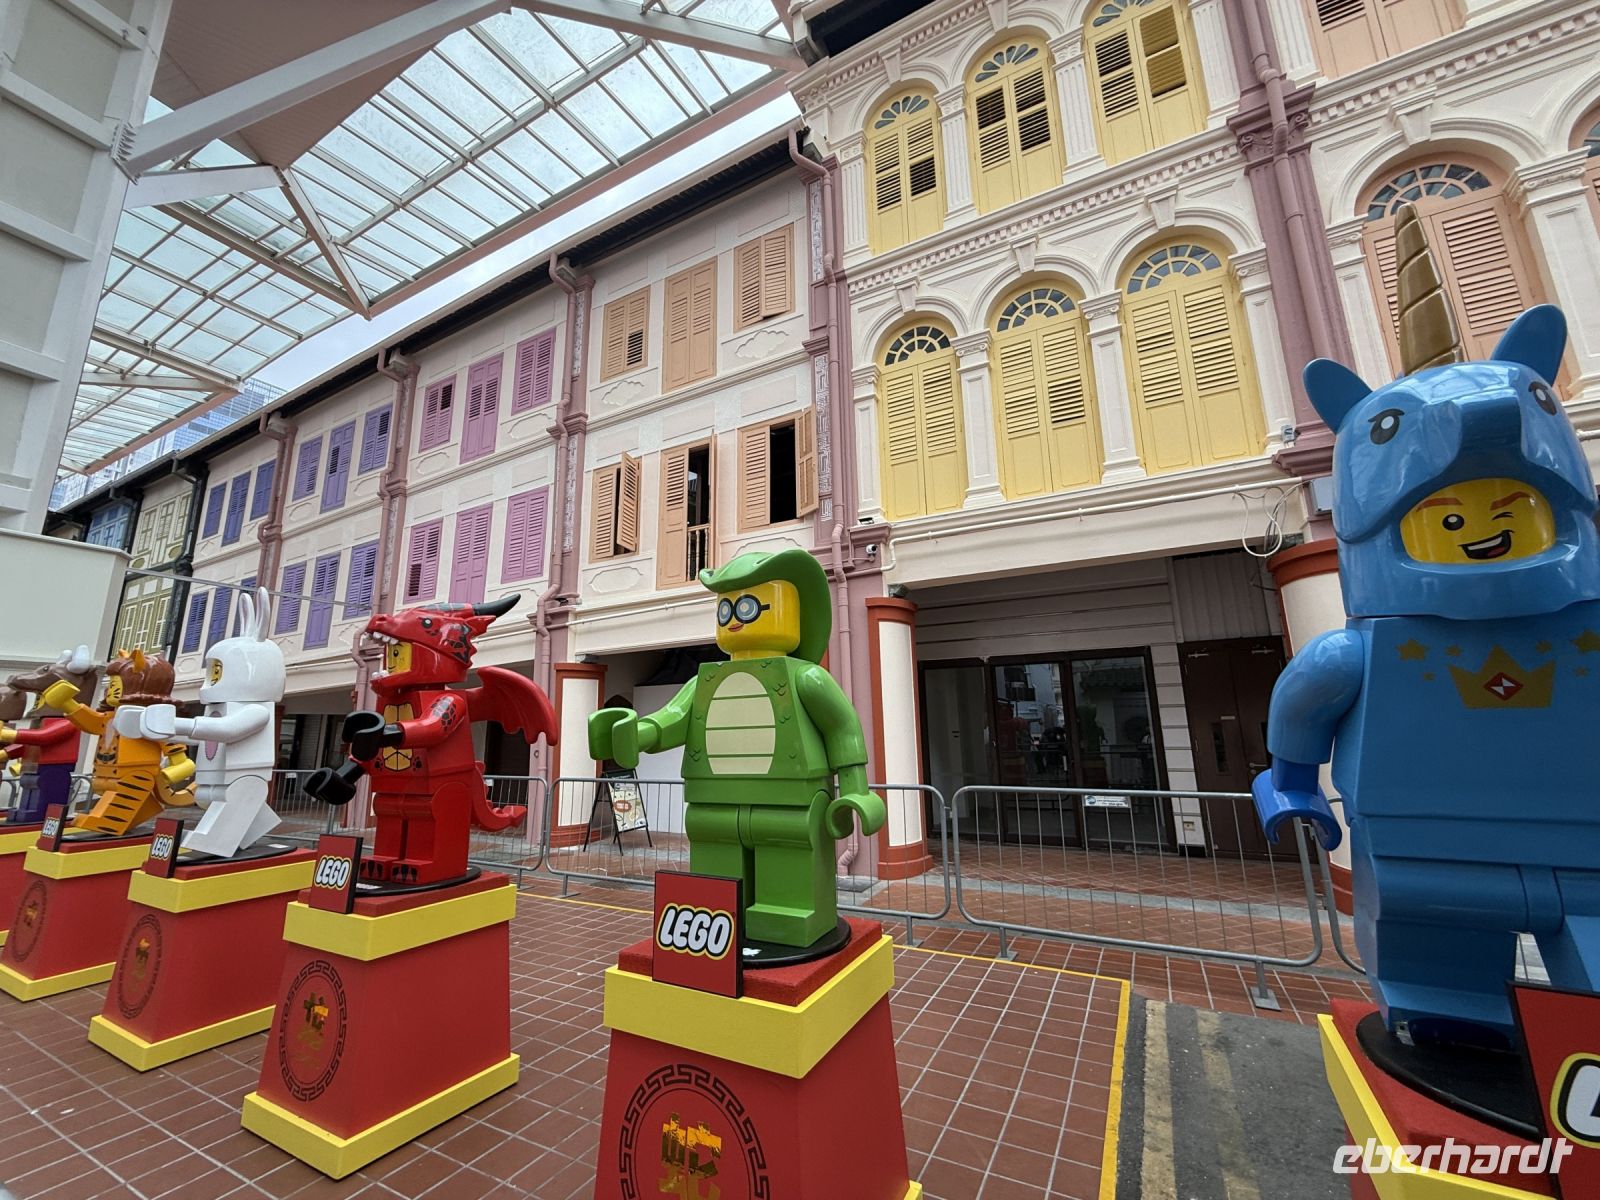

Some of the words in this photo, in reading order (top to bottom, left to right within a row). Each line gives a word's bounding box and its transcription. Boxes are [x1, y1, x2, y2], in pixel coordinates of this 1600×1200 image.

[151, 836, 174, 859] LEGO
[315, 857, 350, 888] LEGO
[658, 906, 732, 957] LEGO
